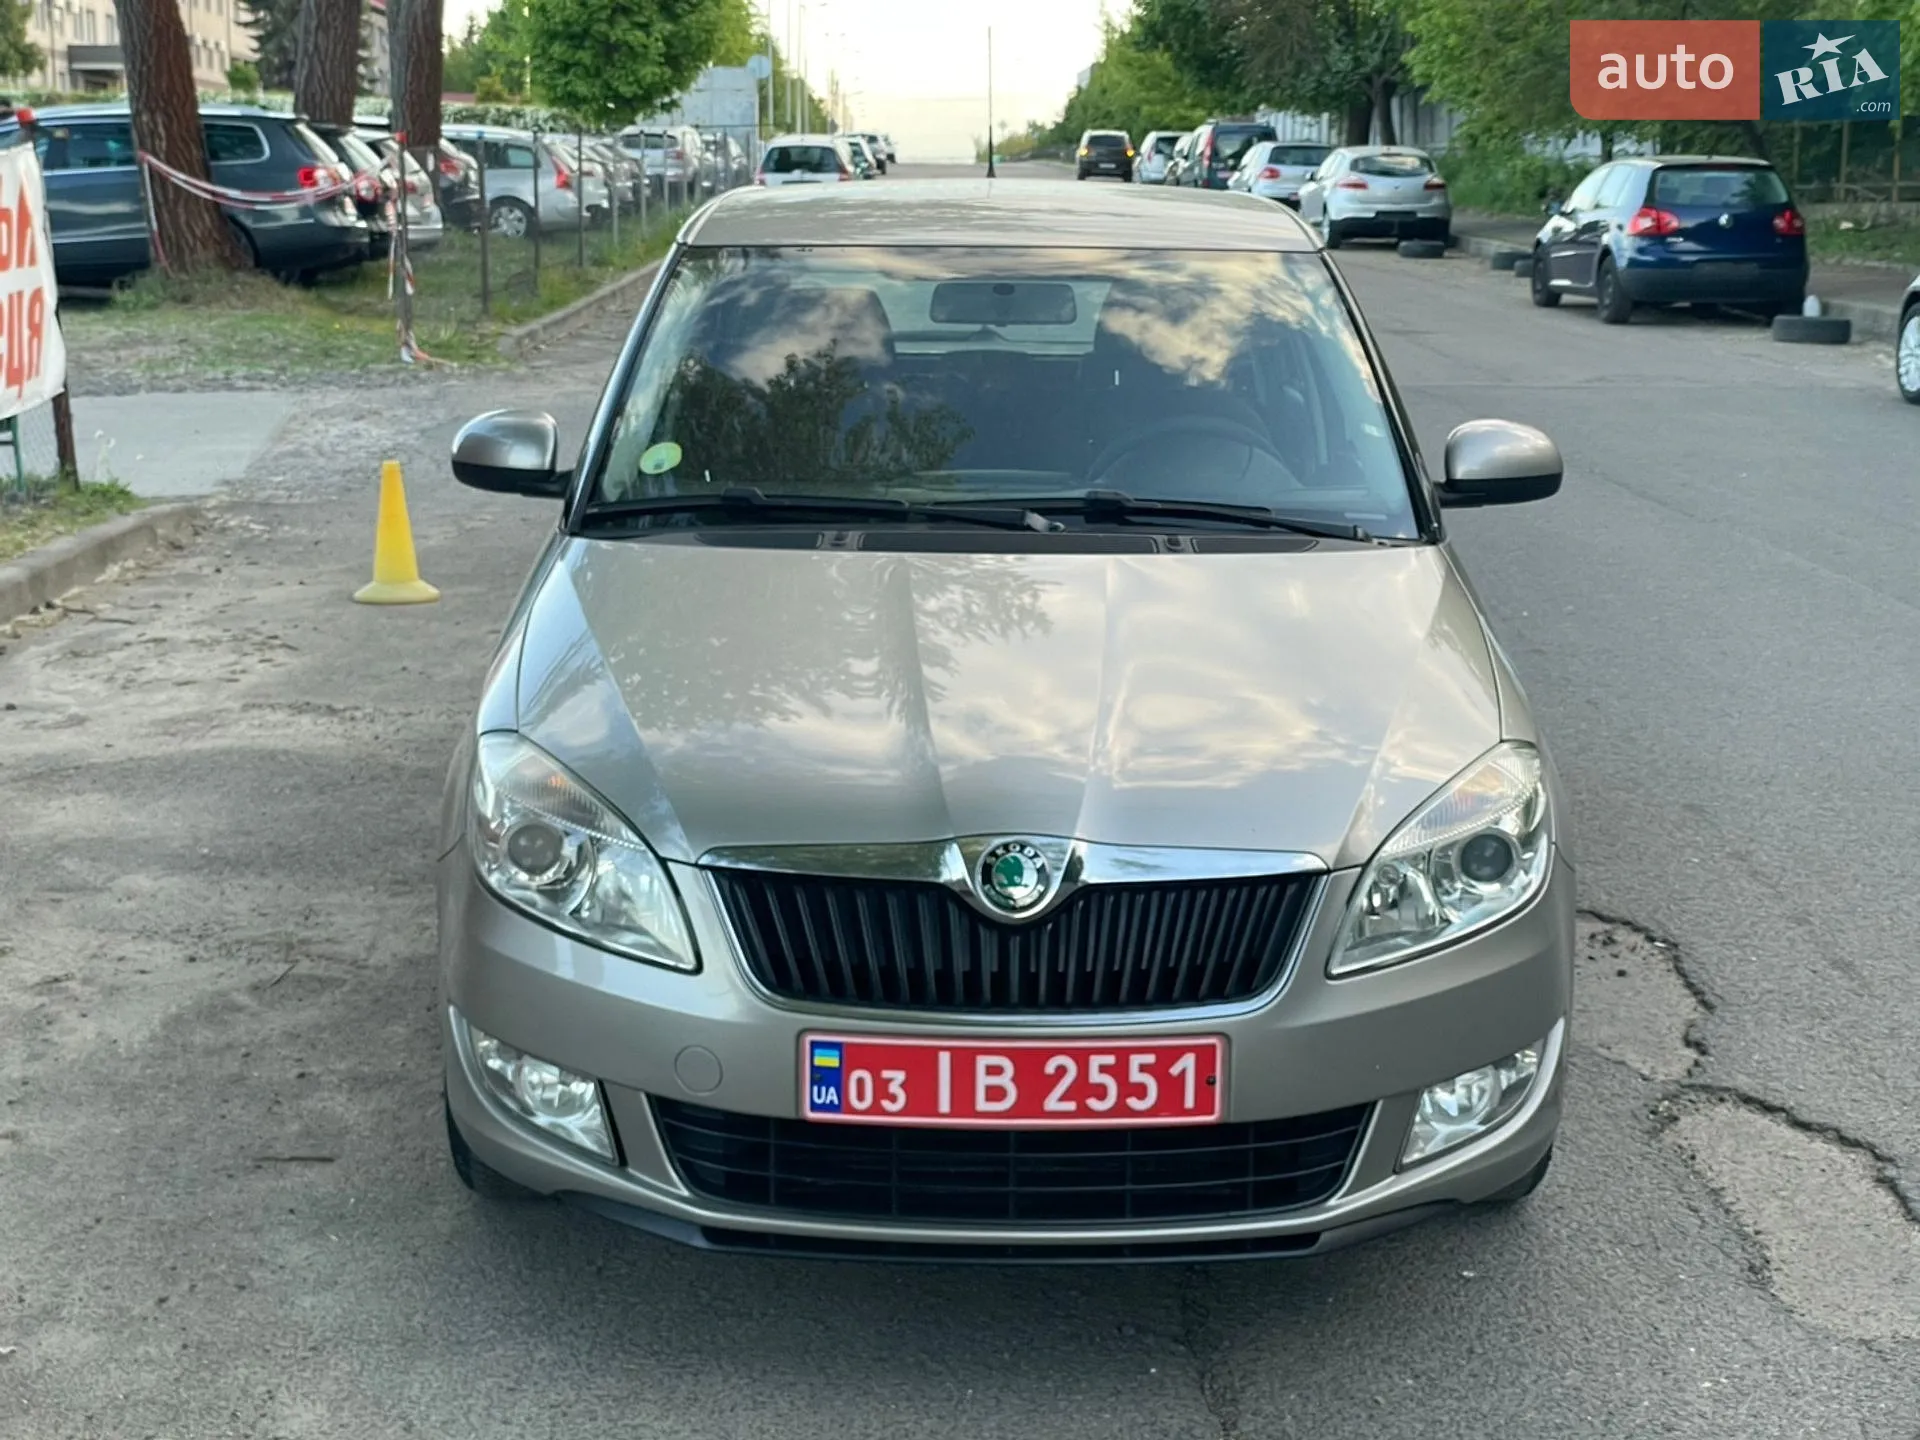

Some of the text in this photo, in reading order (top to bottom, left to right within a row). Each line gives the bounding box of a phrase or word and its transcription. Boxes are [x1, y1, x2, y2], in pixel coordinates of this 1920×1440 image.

[812, 1085, 839, 1105] UA
[848, 1068, 907, 1113] 03
[1043, 1052, 1197, 1113] 2551
